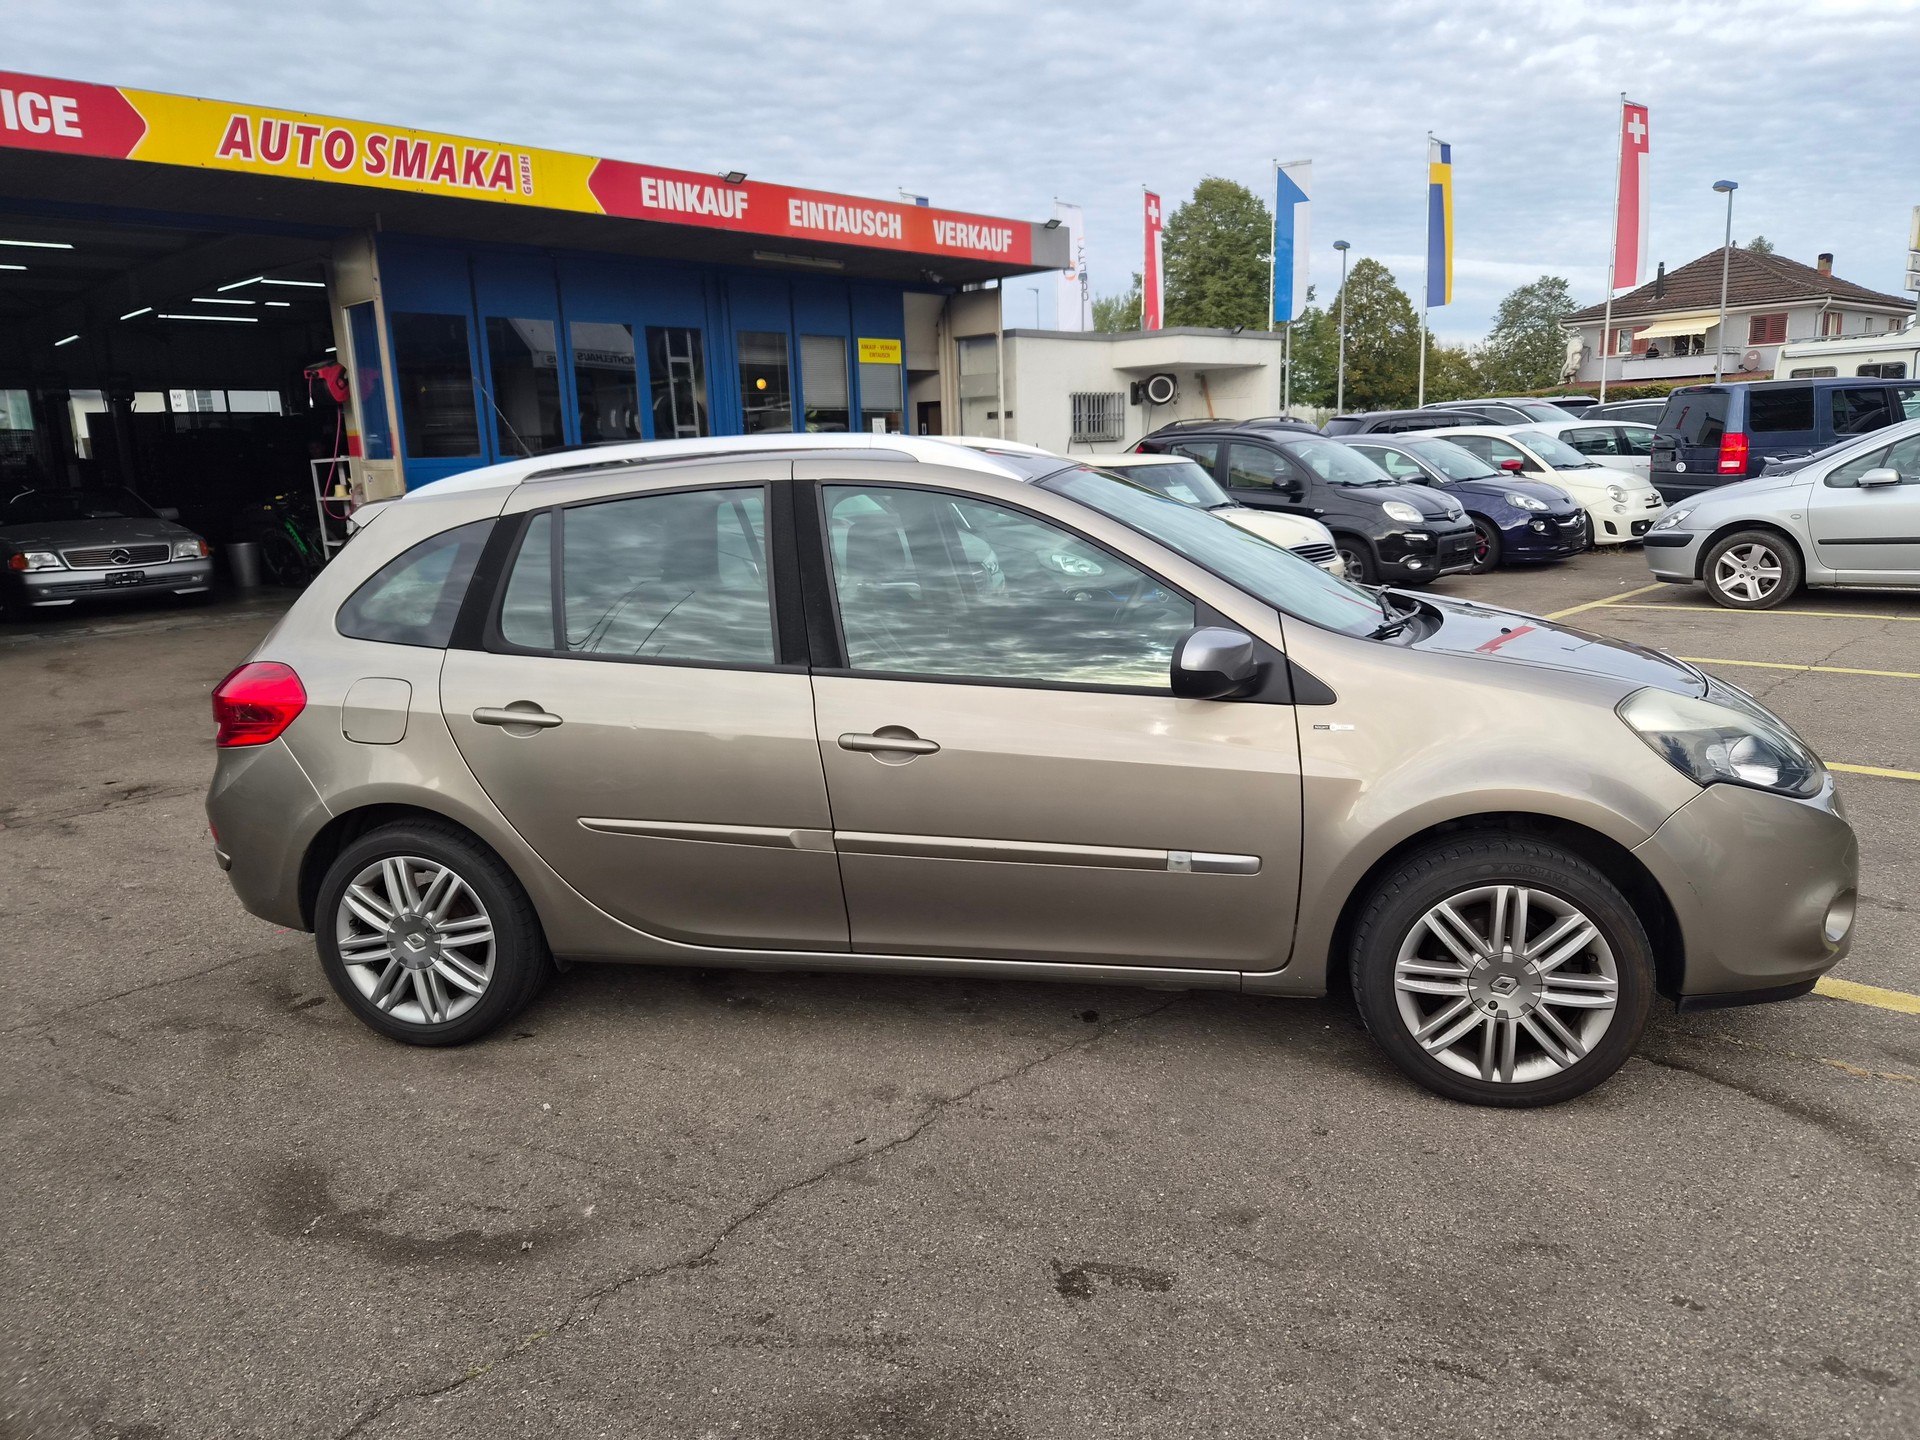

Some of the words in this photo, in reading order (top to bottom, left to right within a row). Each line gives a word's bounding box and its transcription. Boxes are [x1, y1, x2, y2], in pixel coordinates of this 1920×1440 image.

[0, 88, 83, 138] ICE
[217, 115, 356, 171] AUTO
[363, 133, 516, 192] SMAKA
[520, 155, 532, 195] GMBH
[641, 176, 748, 219] EINKAUF
[788, 198, 902, 240] EINTAUSCH
[932, 219, 1012, 253] VERKAUF
[1507, 864, 1569, 886] YOKOHAMA
